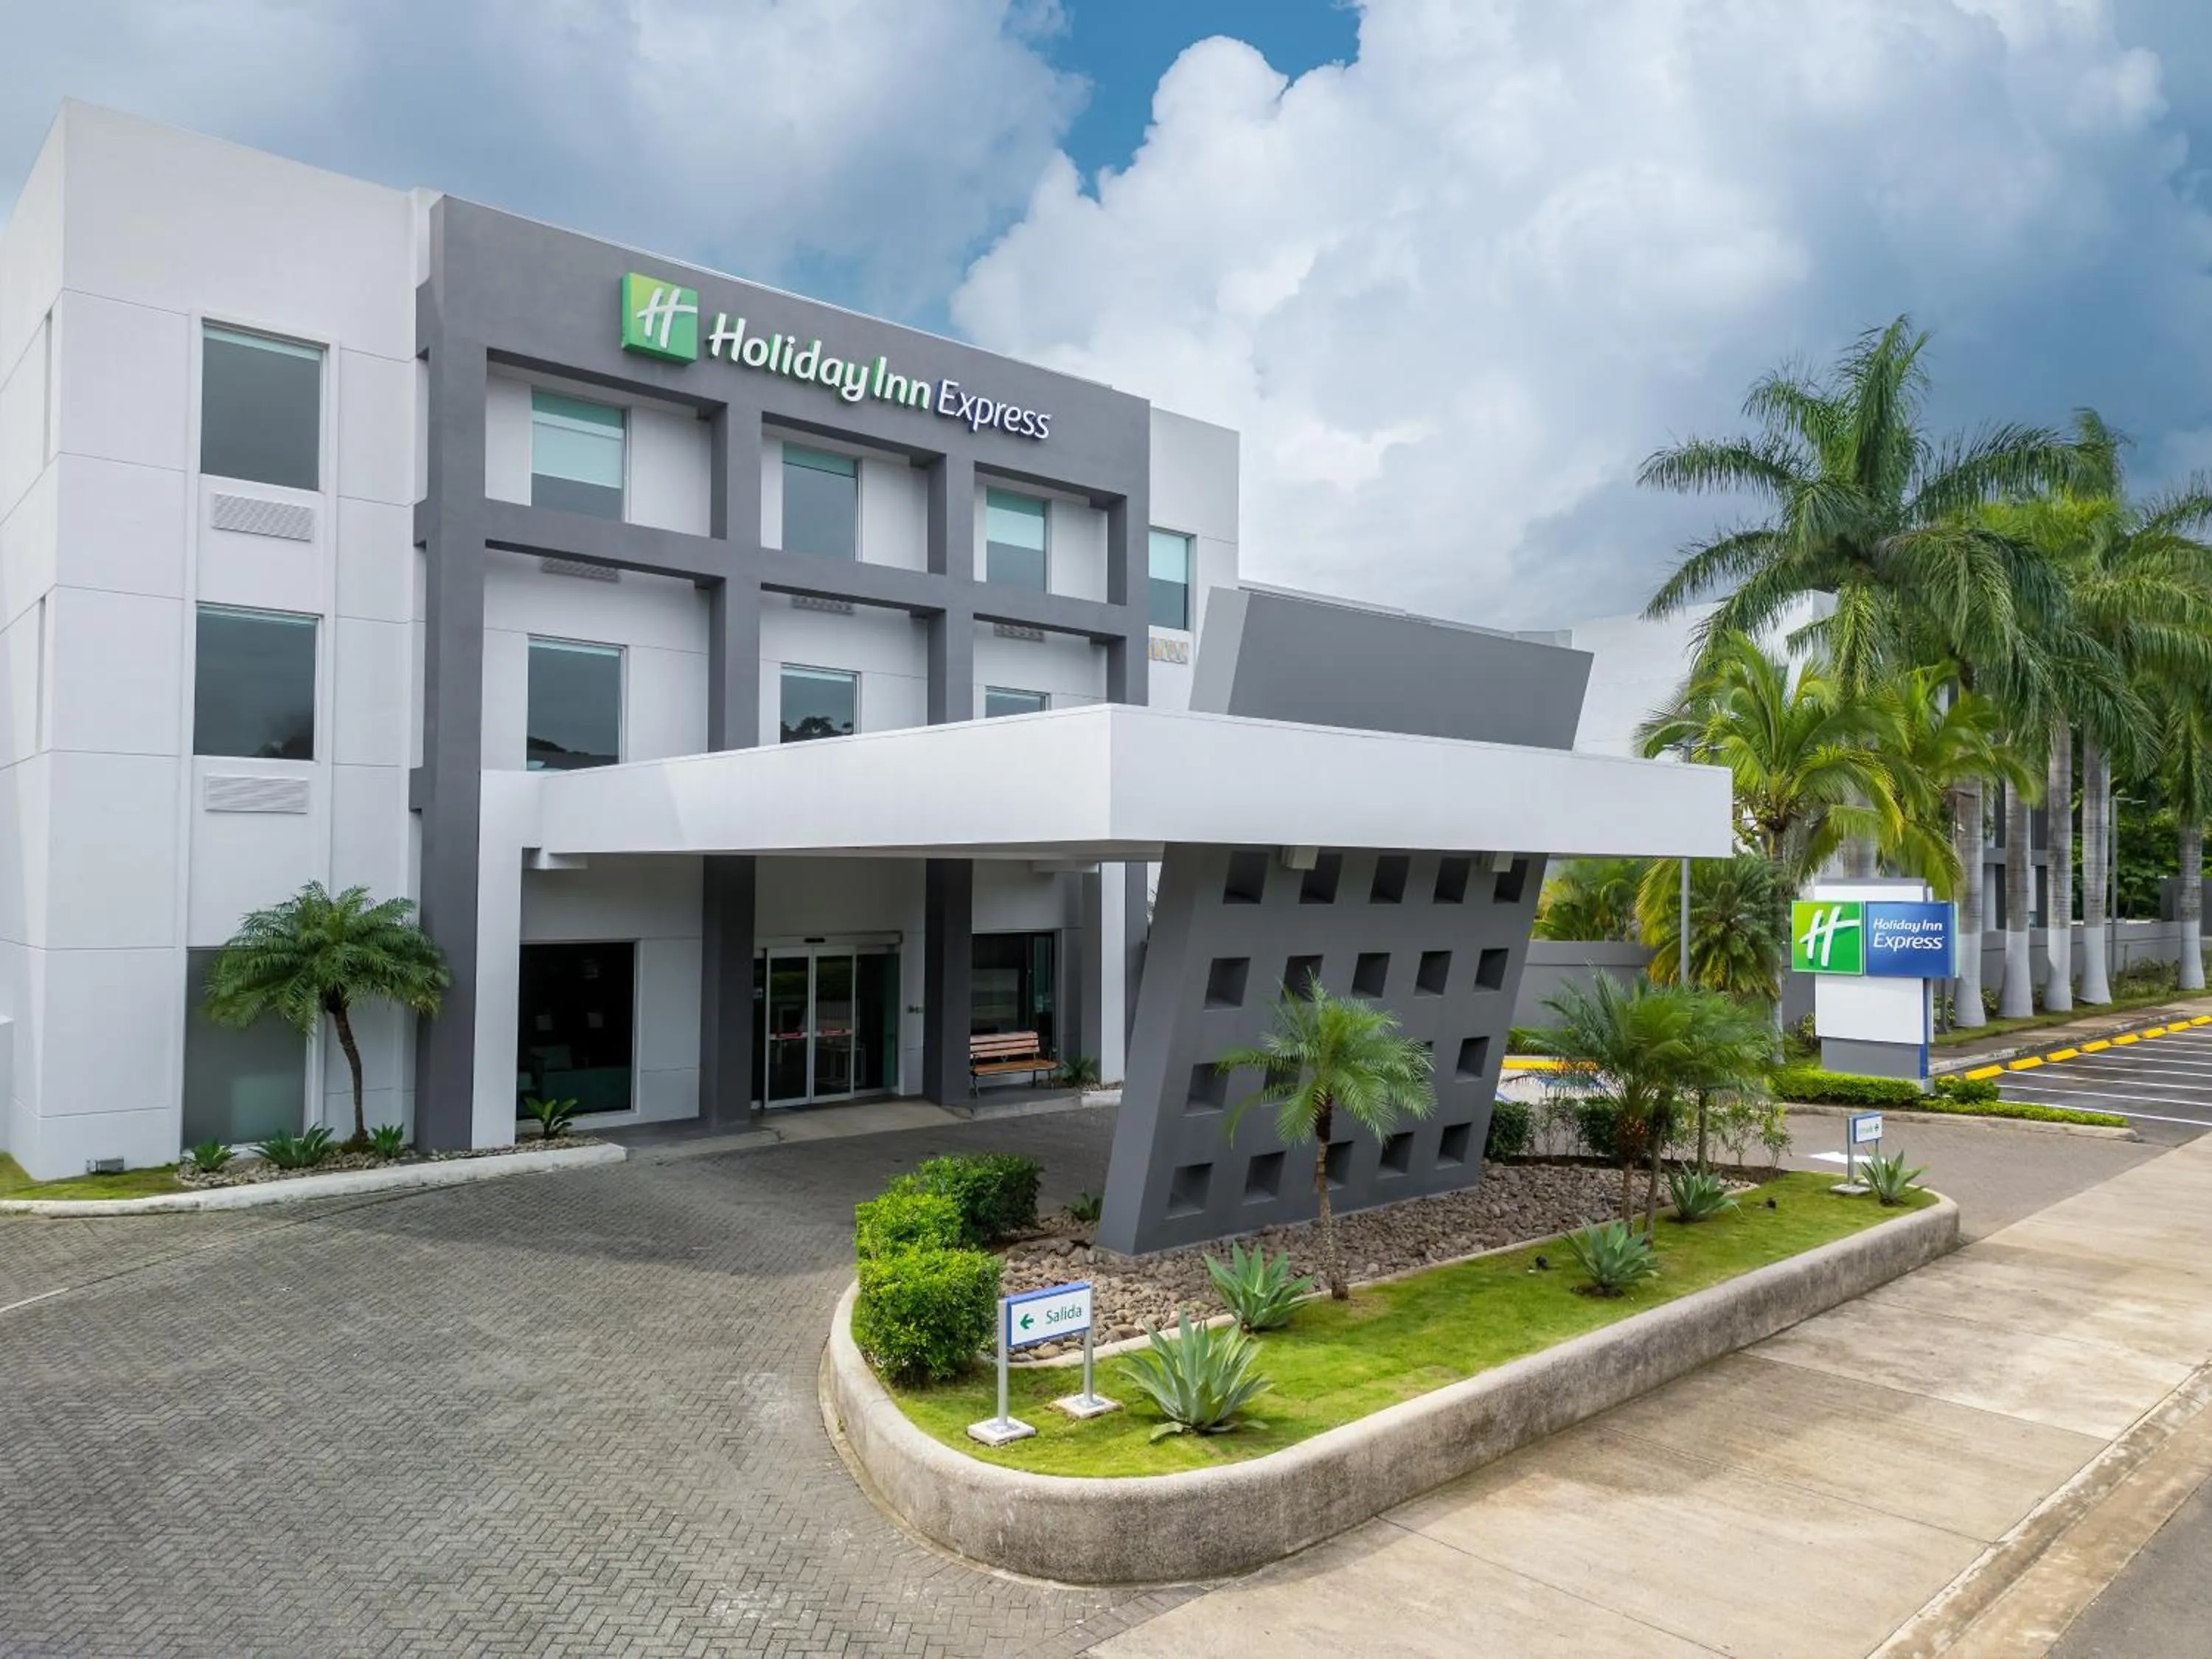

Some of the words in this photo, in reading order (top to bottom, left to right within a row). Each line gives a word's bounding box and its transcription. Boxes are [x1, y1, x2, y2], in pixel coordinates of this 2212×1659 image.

[709, 312, 868, 403] Holiday
[873, 357, 931, 410] Inn
[936, 379, 1051, 441] Express
[1873, 918, 1921, 933] Holiday
[1921, 919, 1943, 931] Inn
[1873, 932, 1944, 952] Express
[1046, 1304, 1082, 1324] Salida
